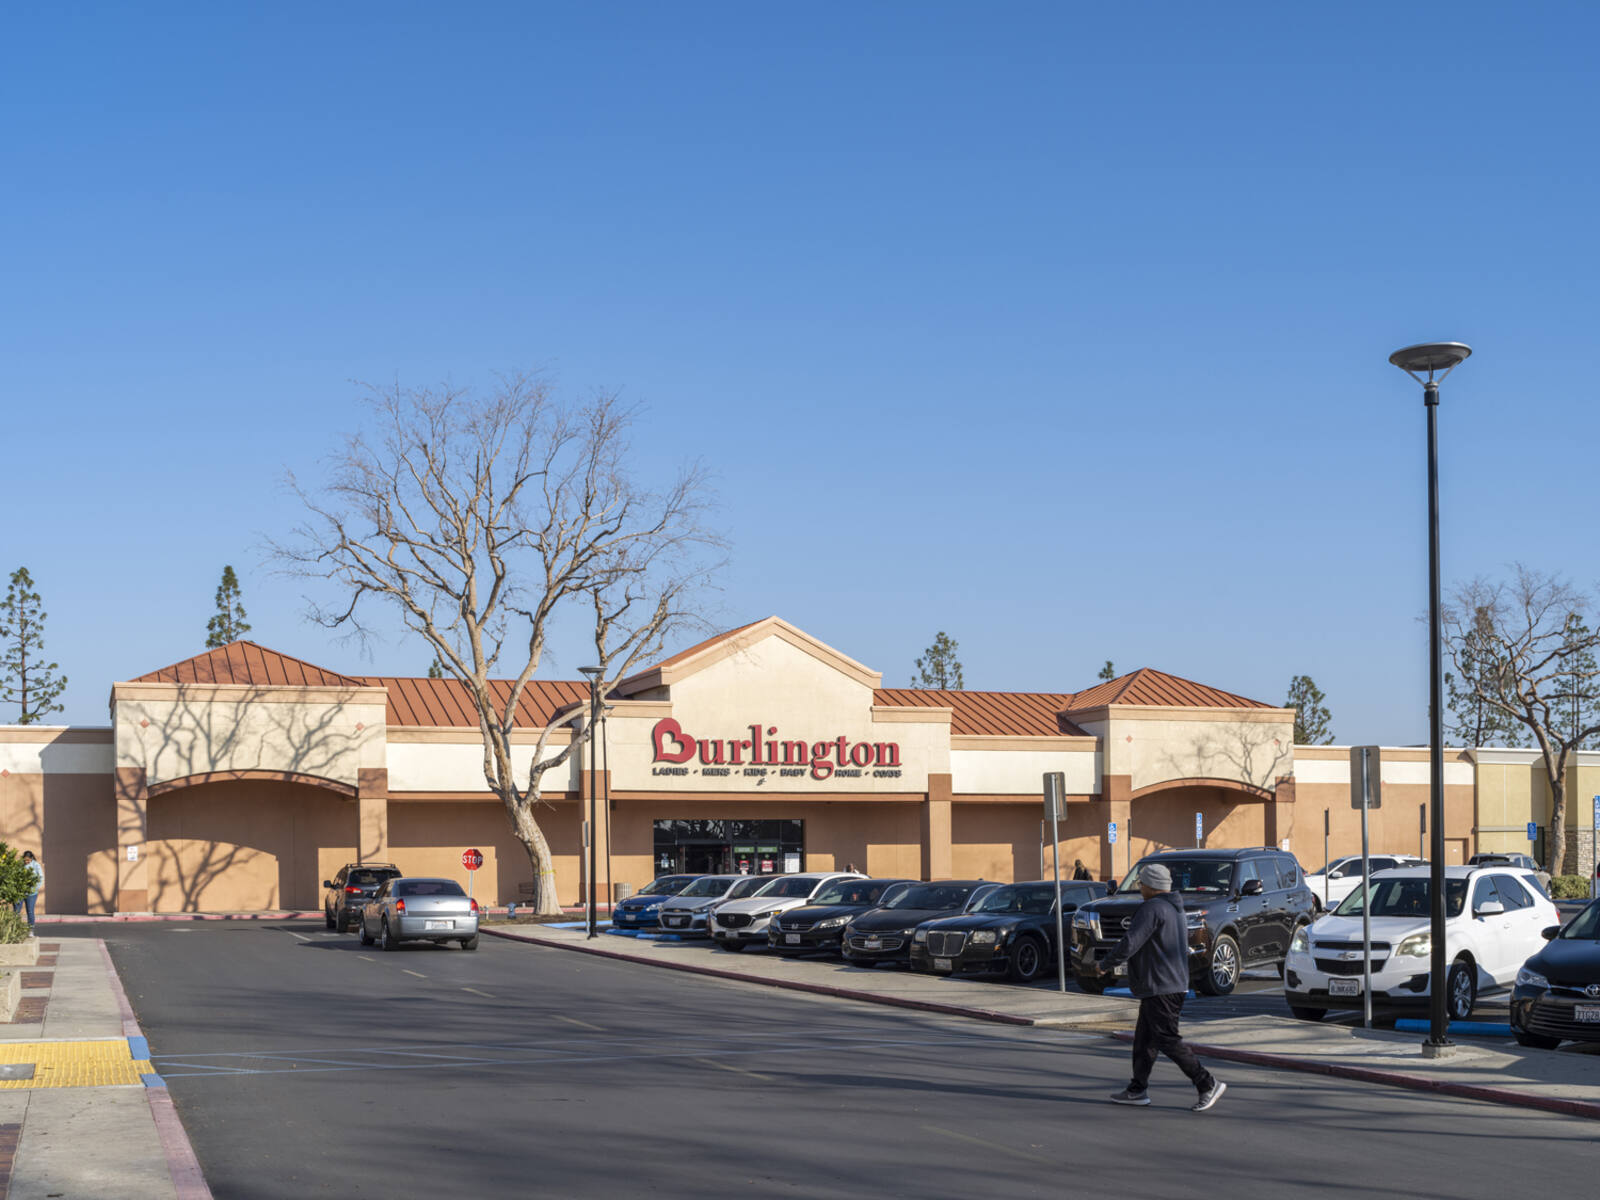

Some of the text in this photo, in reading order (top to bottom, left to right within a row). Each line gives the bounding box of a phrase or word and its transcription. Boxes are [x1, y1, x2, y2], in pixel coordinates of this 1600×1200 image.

[652, 717, 902, 780] Burlington
[652, 767, 689, 776] LADIES
[701, 767, 731, 777] MENS
[743, 768, 768, 777] KIDS
[780, 768, 807, 777] BABY
[834, 769, 862, 778] HOME
[463, 855, 482, 864] STOP
